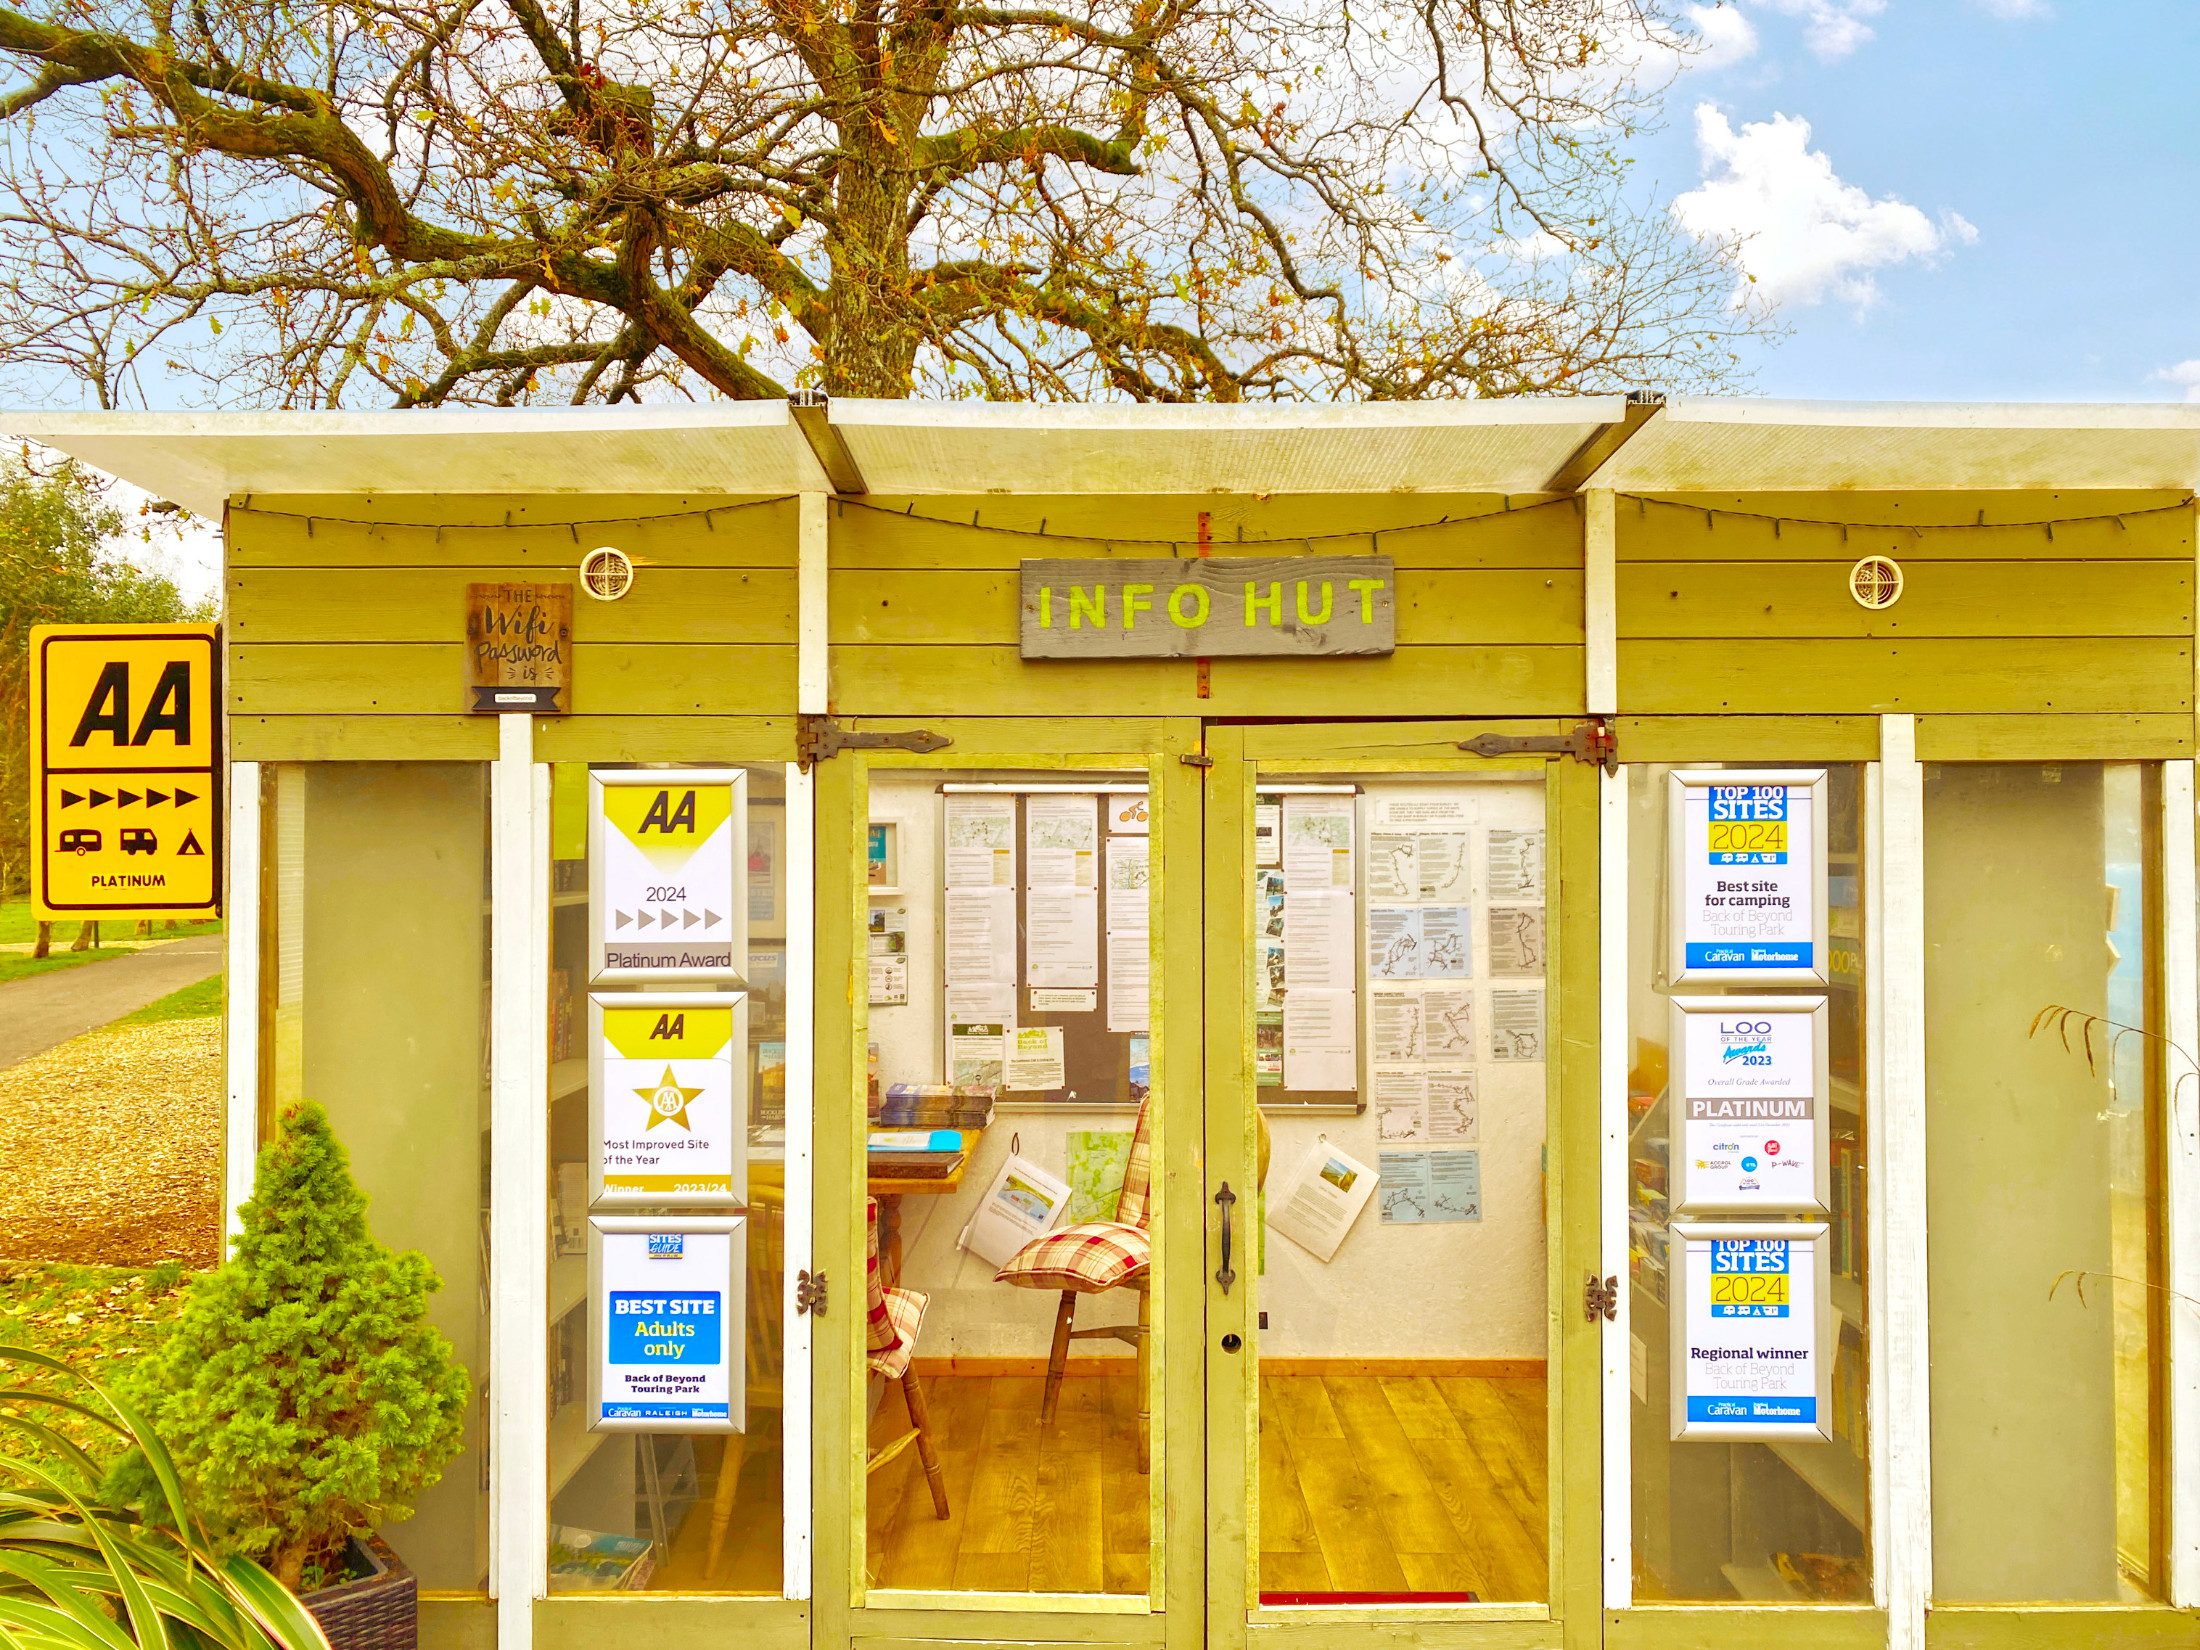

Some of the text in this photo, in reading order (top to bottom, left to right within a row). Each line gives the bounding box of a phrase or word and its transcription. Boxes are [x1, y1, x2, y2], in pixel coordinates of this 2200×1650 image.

[504, 590, 532, 602] THE
[1039, 579, 1384, 629] INFO HUT
[485, 605, 554, 644] Wifi
[523, 666, 537, 680] is
[69, 661, 190, 746] AA
[1714, 786, 1783, 799] TOP 100
[638, 791, 695, 833] AA
[1713, 800, 1783, 820] SITES
[1713, 824, 1783, 849] 2024
[92, 875, 166, 887] PLATINUM
[1717, 880, 1778, 892] Best site
[646, 887, 687, 901] 2024
[1705, 894, 1790, 908] for camping
[1703, 909, 1793, 925] Back of Beyond
[1711, 923, 1785, 938] Touring Park
[607, 952, 731, 968] Platinum Award
[1705, 951, 1745, 961] Caravan
[1751, 951, 1799, 961] Motorhome
[649, 1014, 684, 1040] AA
[1720, 1022, 1771, 1034] LOO
[1723, 1041, 1766, 1063] Awards
[1742, 1056, 1772, 1065] 2023
[1708, 1078, 1791, 1086] Overall Grade Awarded
[1693, 1101, 1805, 1117] PLATINUM
[604, 1140, 709, 1150] Most Improved Site
[615, 1155, 633, 1164] the
[635, 1155, 660, 1164] Year
[604, 1183, 728, 1192] Winner 2023/24
[650, 1234, 682, 1243] SITES
[1716, 1240, 1785, 1251] TOP 100
[1715, 1252, 1785, 1271] SITES
[1715, 1276, 1785, 1302] 2024
[615, 1300, 715, 1314] BEST SITE
[634, 1321, 695, 1336] Adults
[644, 1340, 685, 1359] only
[1691, 1347, 1809, 1361] Regional winner
[1705, 1362, 1795, 1377] Back of Beyond
[665, 1375, 706, 1384] Beyond
[1713, 1376, 1787, 1391] Touring Park
[631, 1385, 700, 1394] Touring Park
[608, 1408, 641, 1417] Caravan
[1707, 1405, 1747, 1415] Caravan
[1753, 1406, 1800, 1415] Motorhome
